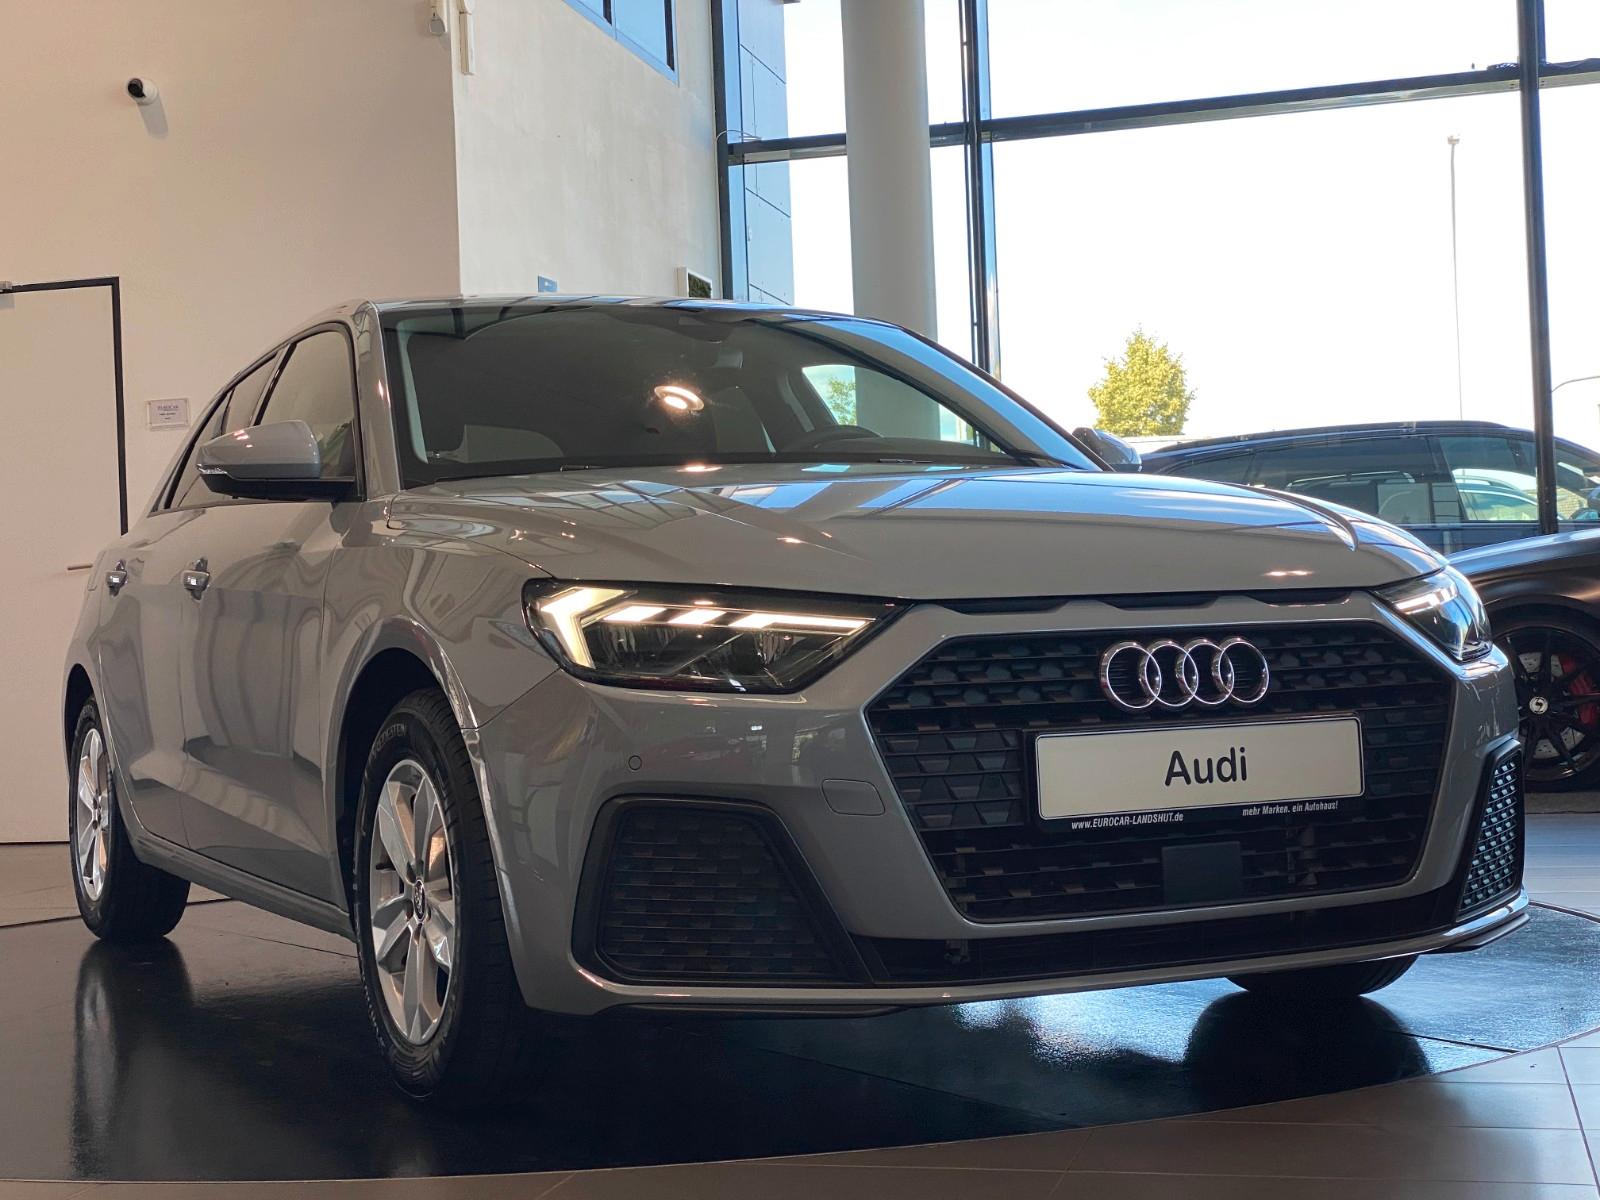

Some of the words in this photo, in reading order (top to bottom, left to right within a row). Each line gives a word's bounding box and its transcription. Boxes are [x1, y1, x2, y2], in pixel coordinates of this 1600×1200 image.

[1164, 747, 1247, 786] Audi
[1242, 806, 1260, 816] mehr
[1292, 803, 1303, 813] ein
[1304, 801, 1339, 812] Autohaus!
[1071, 812, 1184, 830] www.EUROCAR-LANDSHUT.de
